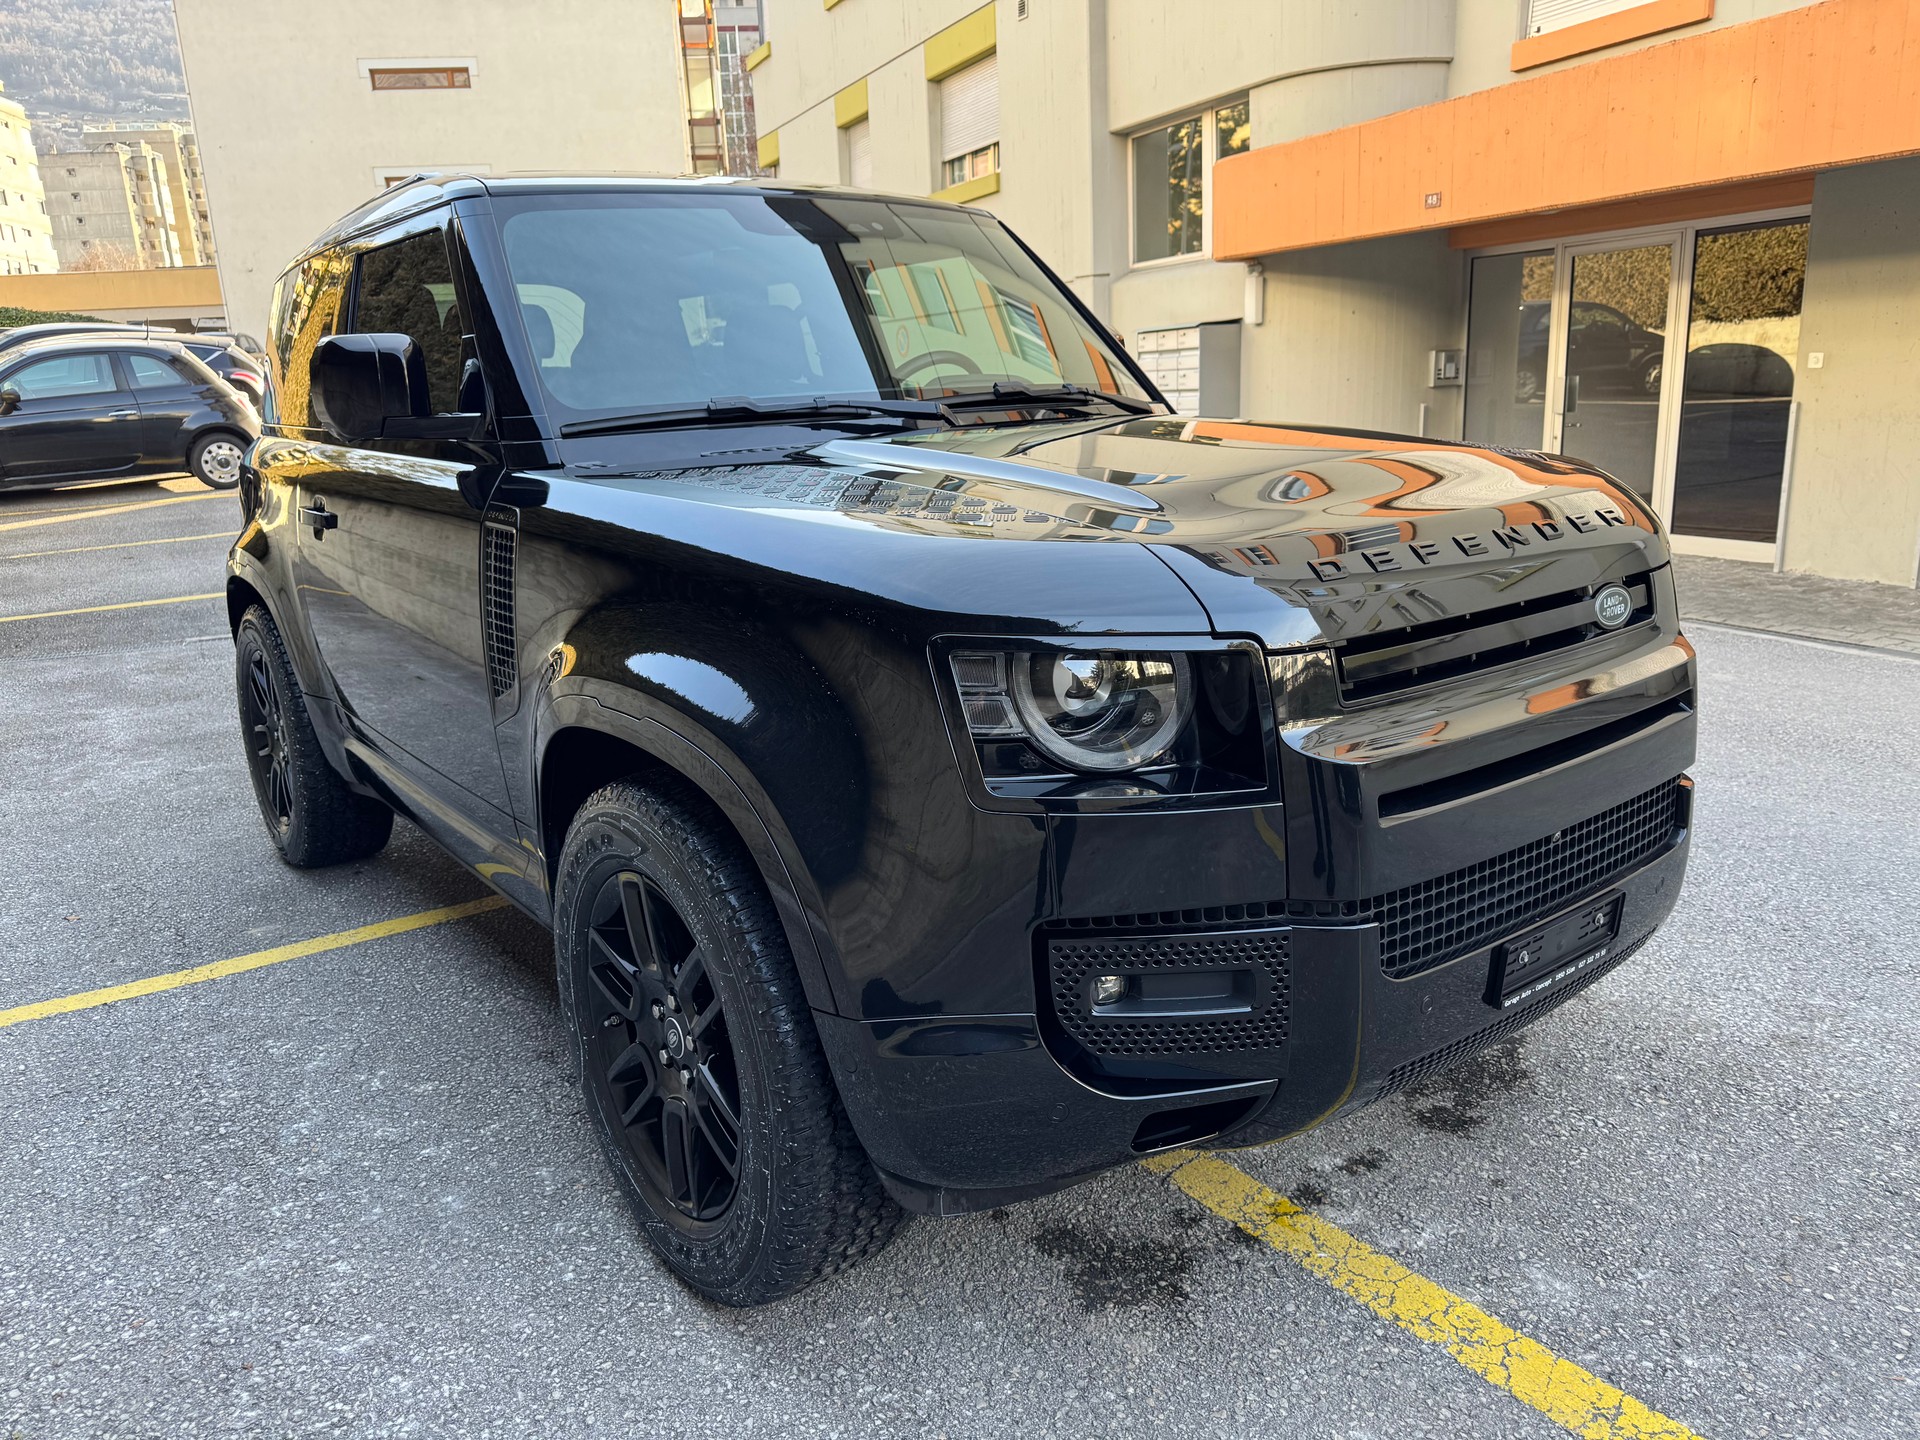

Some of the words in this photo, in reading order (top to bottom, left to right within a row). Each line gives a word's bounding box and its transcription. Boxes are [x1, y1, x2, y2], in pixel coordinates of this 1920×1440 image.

[1307, 508, 1627, 582] DEFENDER
[1603, 595, 1620, 608] LAND
[1605, 603, 1625, 618] ROVER
[1520, 989, 1532, 999] Auto
[1535, 978, 1553, 991] Concept
